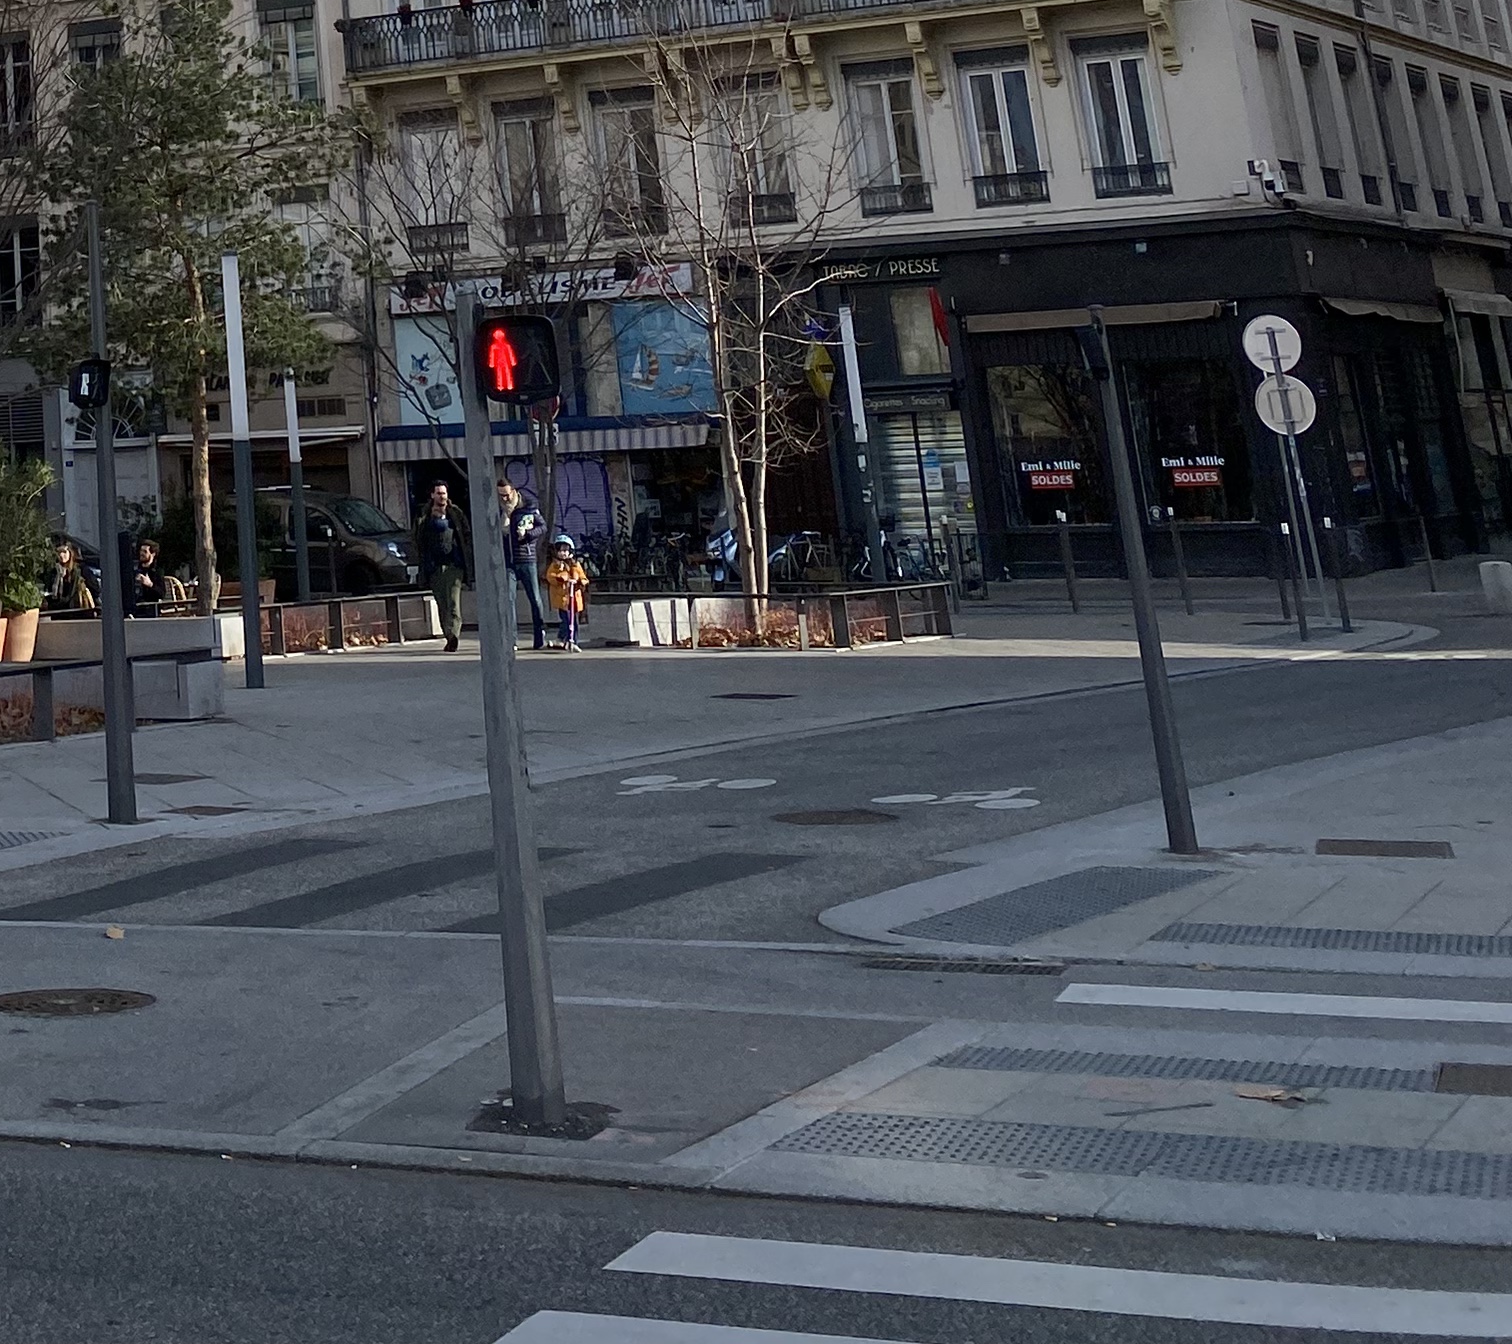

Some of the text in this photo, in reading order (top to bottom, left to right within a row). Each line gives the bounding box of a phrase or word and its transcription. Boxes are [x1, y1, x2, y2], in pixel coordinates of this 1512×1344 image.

[823, 263, 869, 280] TABAC
[889, 258, 940, 275] PRESSE
[1032, 475, 1073, 485] SOLDES
[1174, 472, 1218, 482] SOLDES
